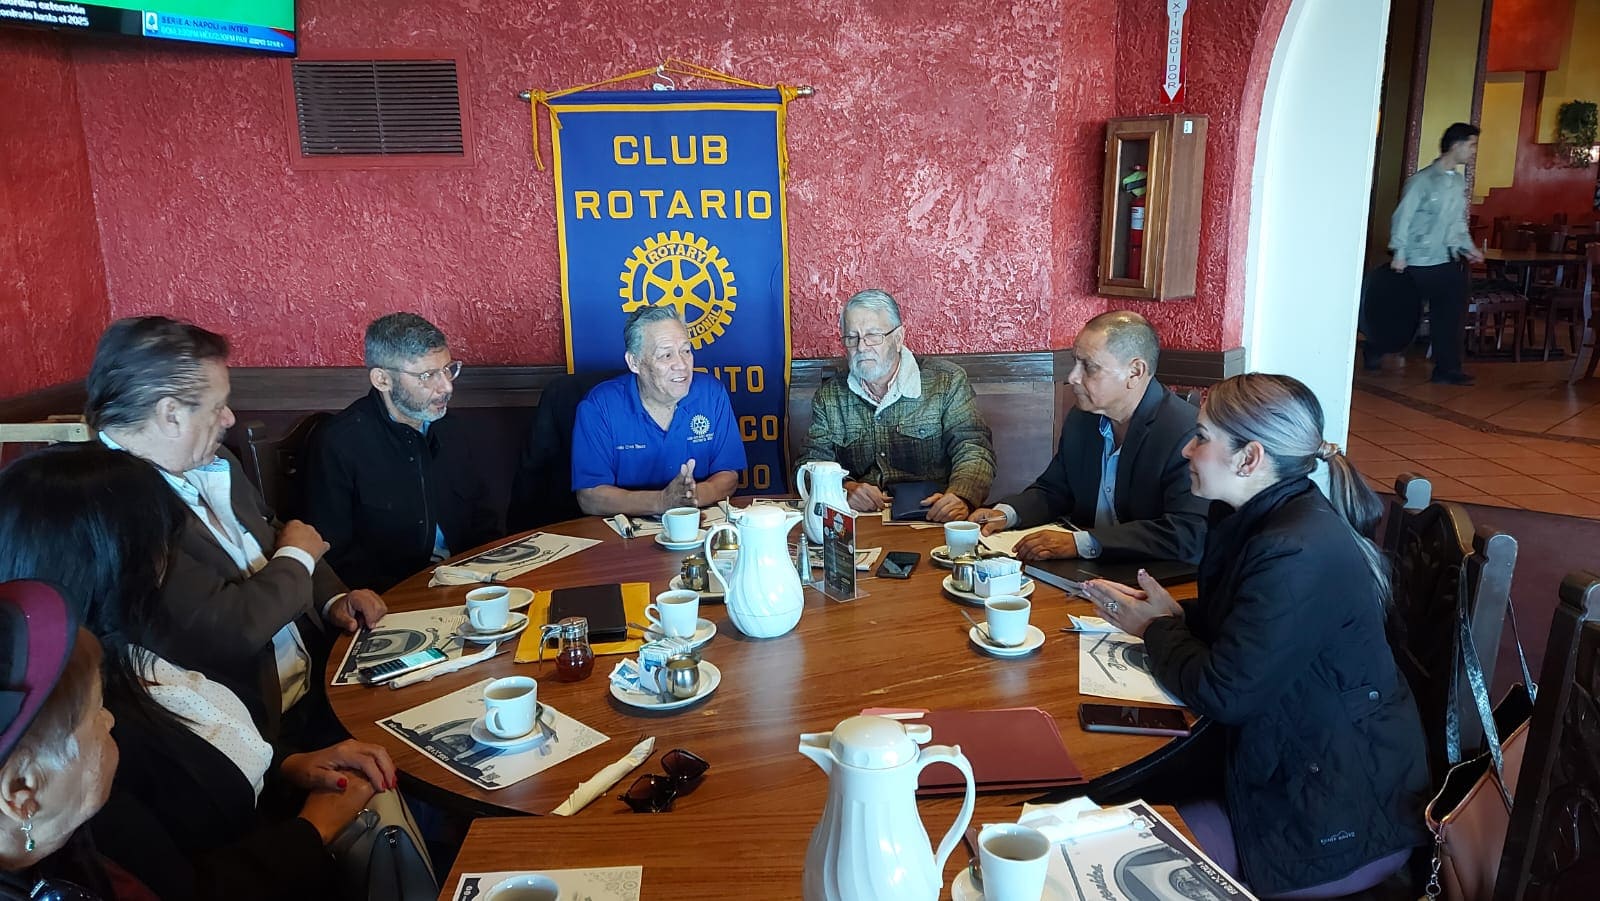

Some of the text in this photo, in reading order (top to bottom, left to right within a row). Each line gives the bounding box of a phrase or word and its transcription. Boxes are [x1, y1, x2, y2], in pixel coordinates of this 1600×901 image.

[0, 8, 33, 20] ontrato
[67, 14, 90, 27] 2025
[38, 1, 86, 15] extensión
[161, 15, 183, 26] SERIE
[193, 19, 220, 31] NAPOLI
[228, 24, 249, 34] INTER
[1167, 1, 1182, 89] XTINGUIDOR
[613, 135, 728, 165] CLUB
[574, 190, 772, 220] ROTARIO
[647, 244, 707, 263] ROTARY
[687, 309, 723, 339] TIONAL
[739, 415, 778, 442] CO
